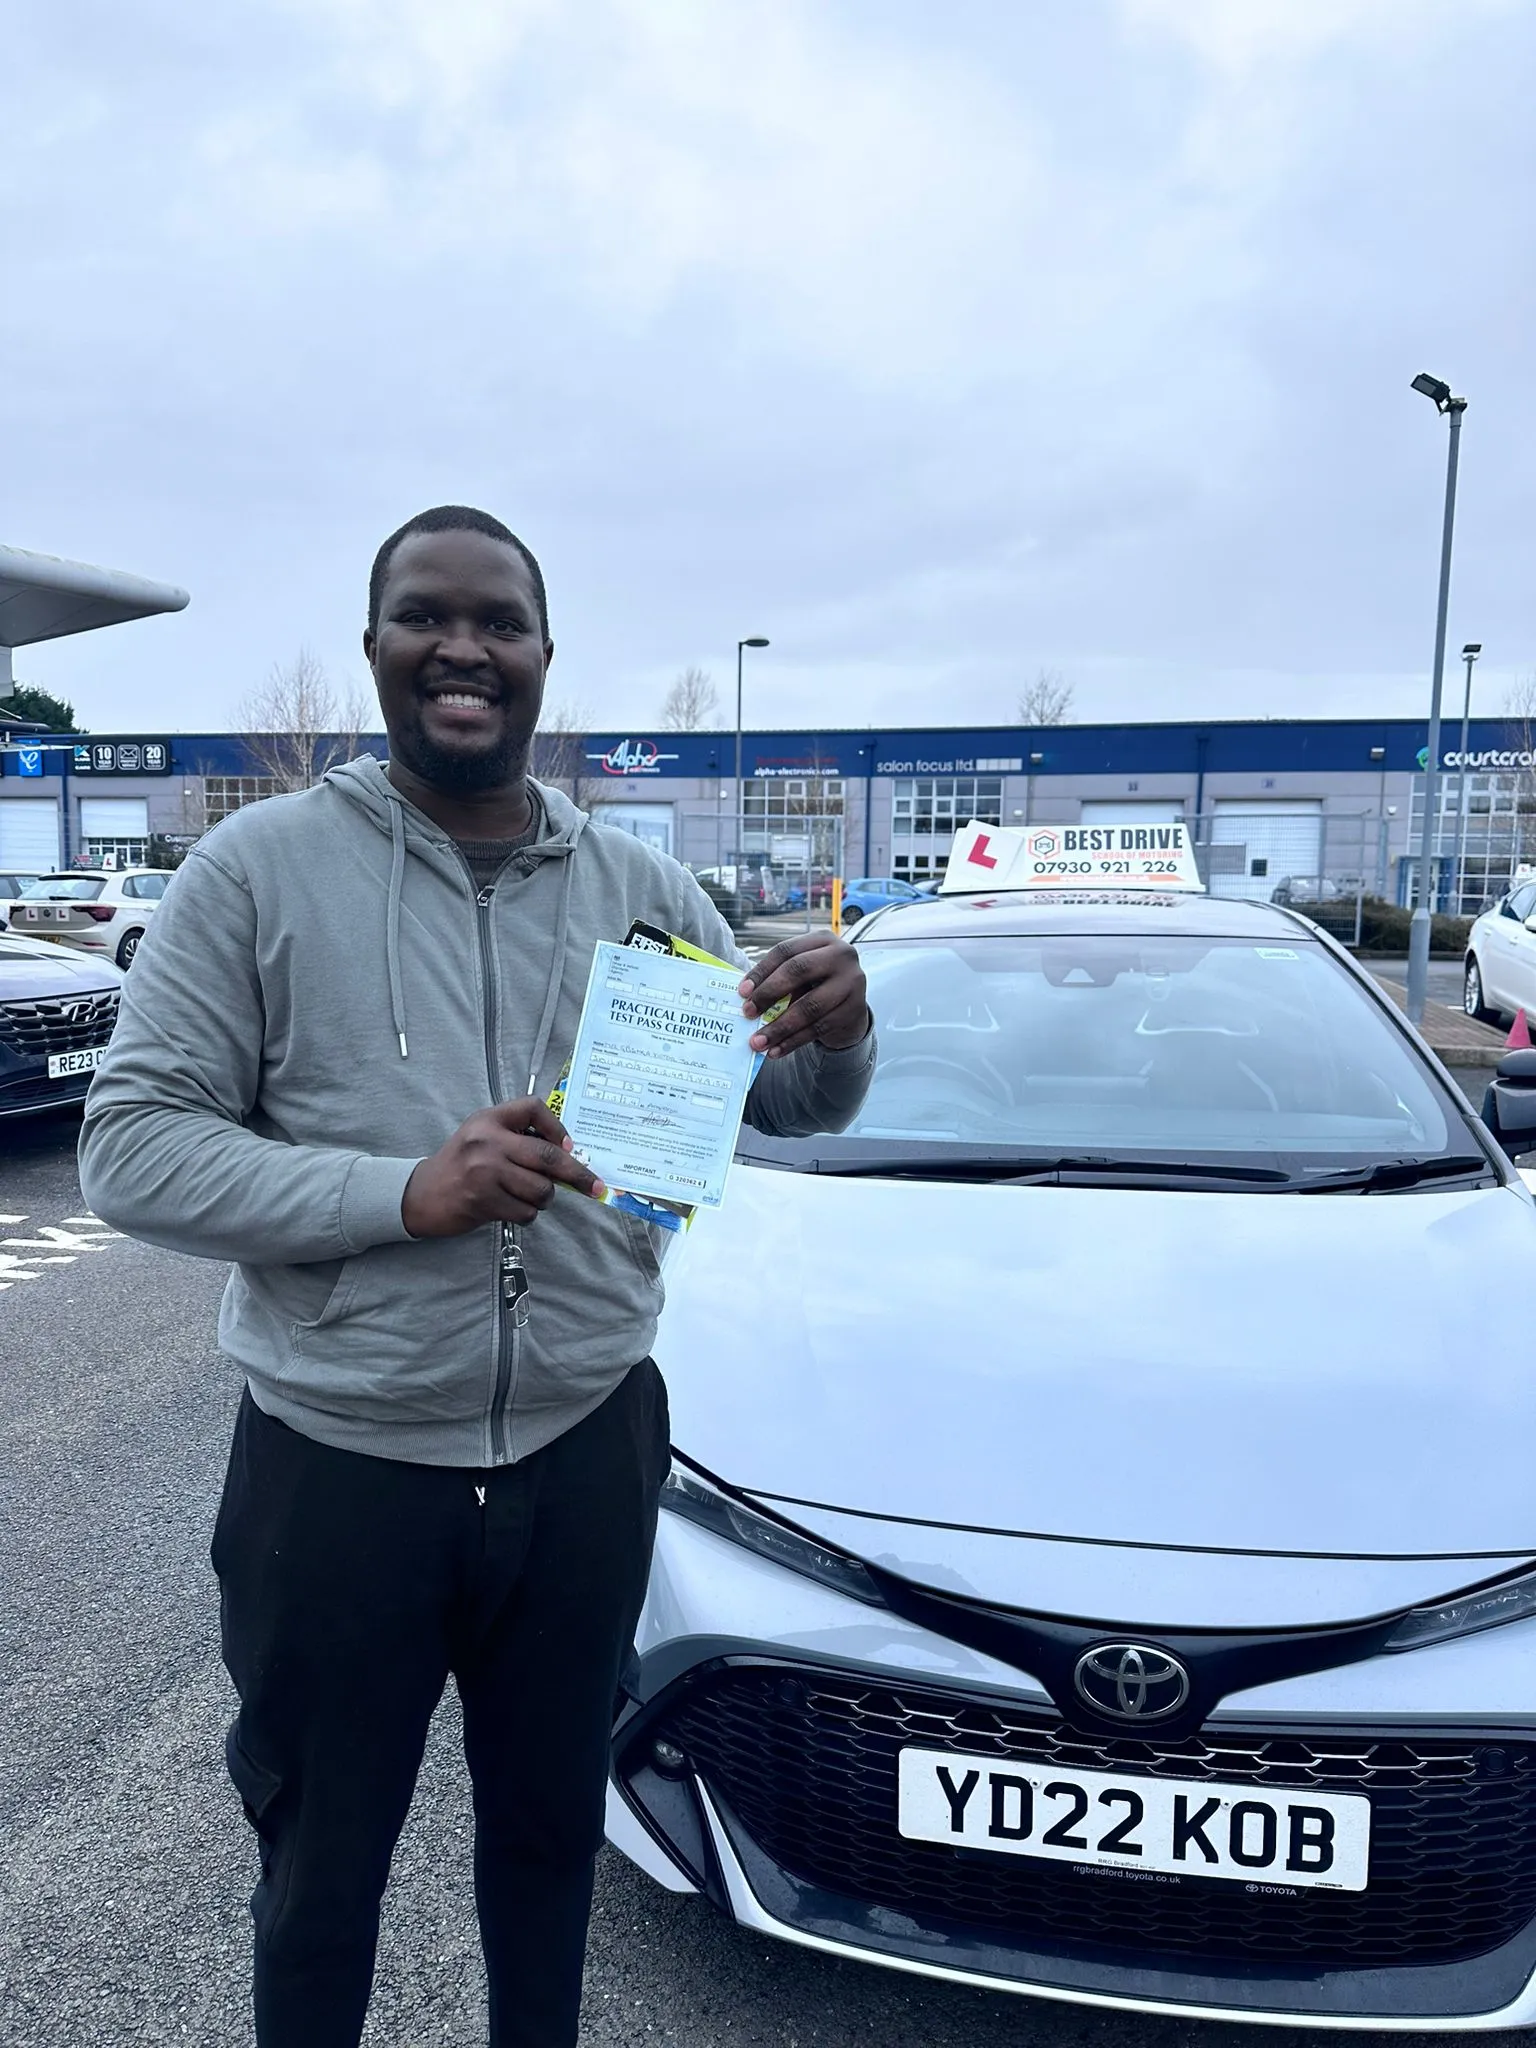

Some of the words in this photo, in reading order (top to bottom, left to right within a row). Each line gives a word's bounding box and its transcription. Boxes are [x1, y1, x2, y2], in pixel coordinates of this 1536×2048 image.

[97, 747, 112, 760] 10
[146, 747, 161, 759] 20
[877, 759, 913, 773] salon
[916, 759, 953, 772] focus
[1064, 829, 1115, 851] BEST
[1120, 828, 1183, 850] DRIVE
[967, 833, 998, 870] L
[1138, 851, 1183, 859] MOTORING
[1034, 861, 1092, 874] 07930
[1100, 861, 1130, 873] 921
[1142, 861, 1177, 873] 226
[631, 932, 669, 955] FIRST
[611, 999, 676, 1022] PRACTICAL
[680, 1013, 734, 1034] DRIVING
[610, 1011, 634, 1024] TEST
[637, 1017, 662, 1030] PASS
[665, 1022, 731, 1045] CERTIFICATE
[59, 1052, 93, 1073] RE23
[624, 1163, 657, 1174] IMPORTANT
[936, 1765, 1144, 1856] YD22
[1172, 1794, 1337, 1874] KOB
[1073, 1865, 1181, 1884] rrgbradford.toyota.co.uk
[1260, 1885, 1297, 1896] TOYOTA
